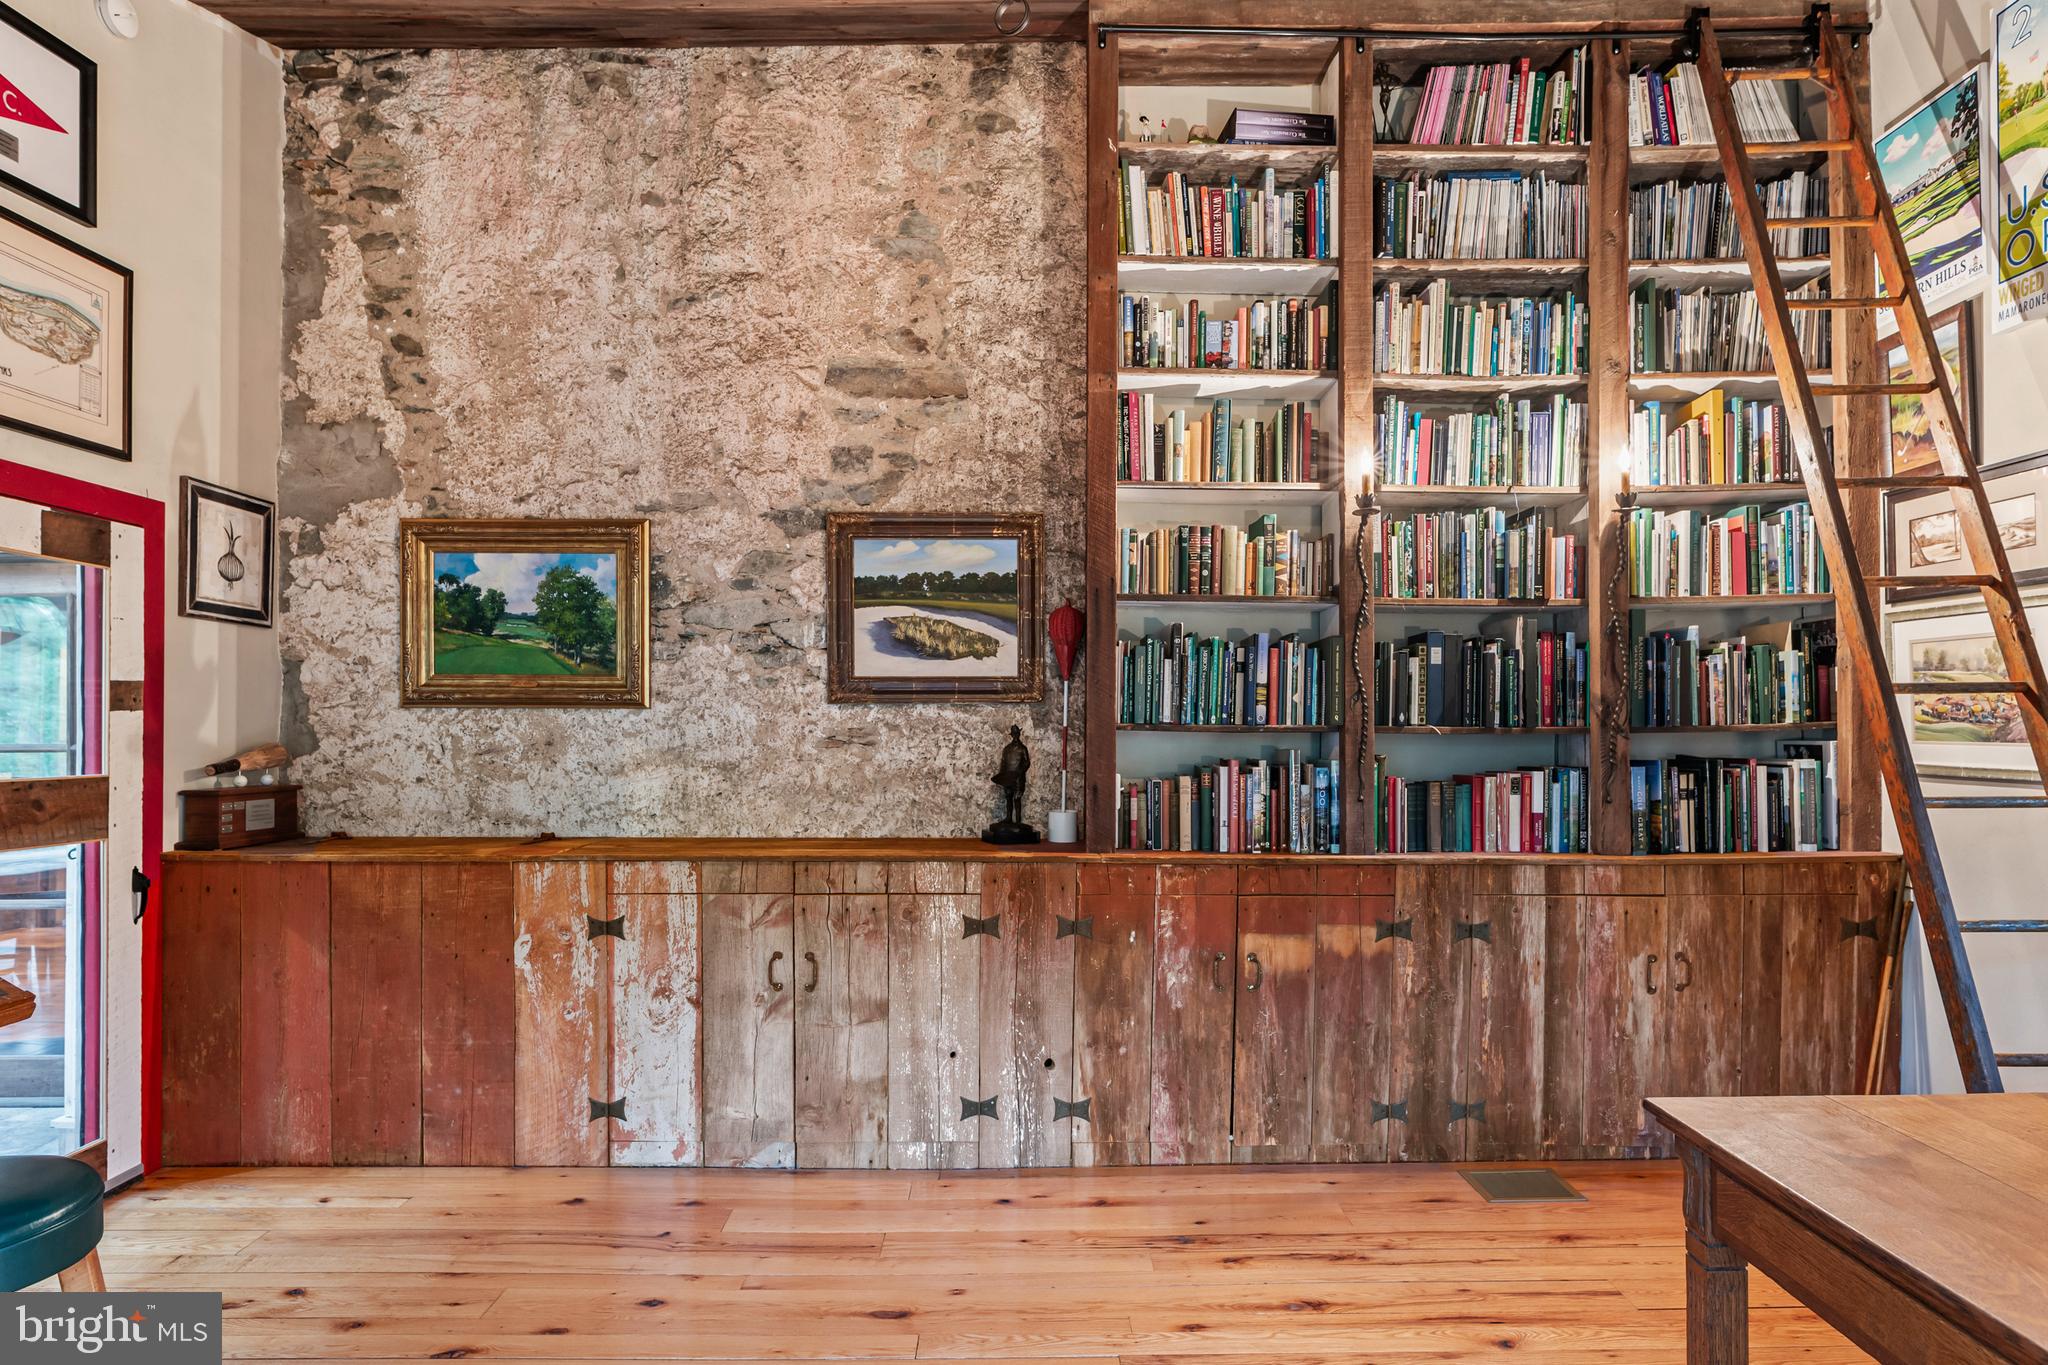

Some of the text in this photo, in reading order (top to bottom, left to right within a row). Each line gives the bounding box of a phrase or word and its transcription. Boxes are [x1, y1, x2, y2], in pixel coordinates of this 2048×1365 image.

[1660, 120, 1670, 141] ATLAS
[1297, 197, 1305, 223] GOLF
[1213, 197, 1222, 253] WINE BIBLE
[1935, 259, 1967, 286] HILLS
[1998, 271, 2045, 306] WINGED
[1998, 296, 2048, 322] MAMARONE
